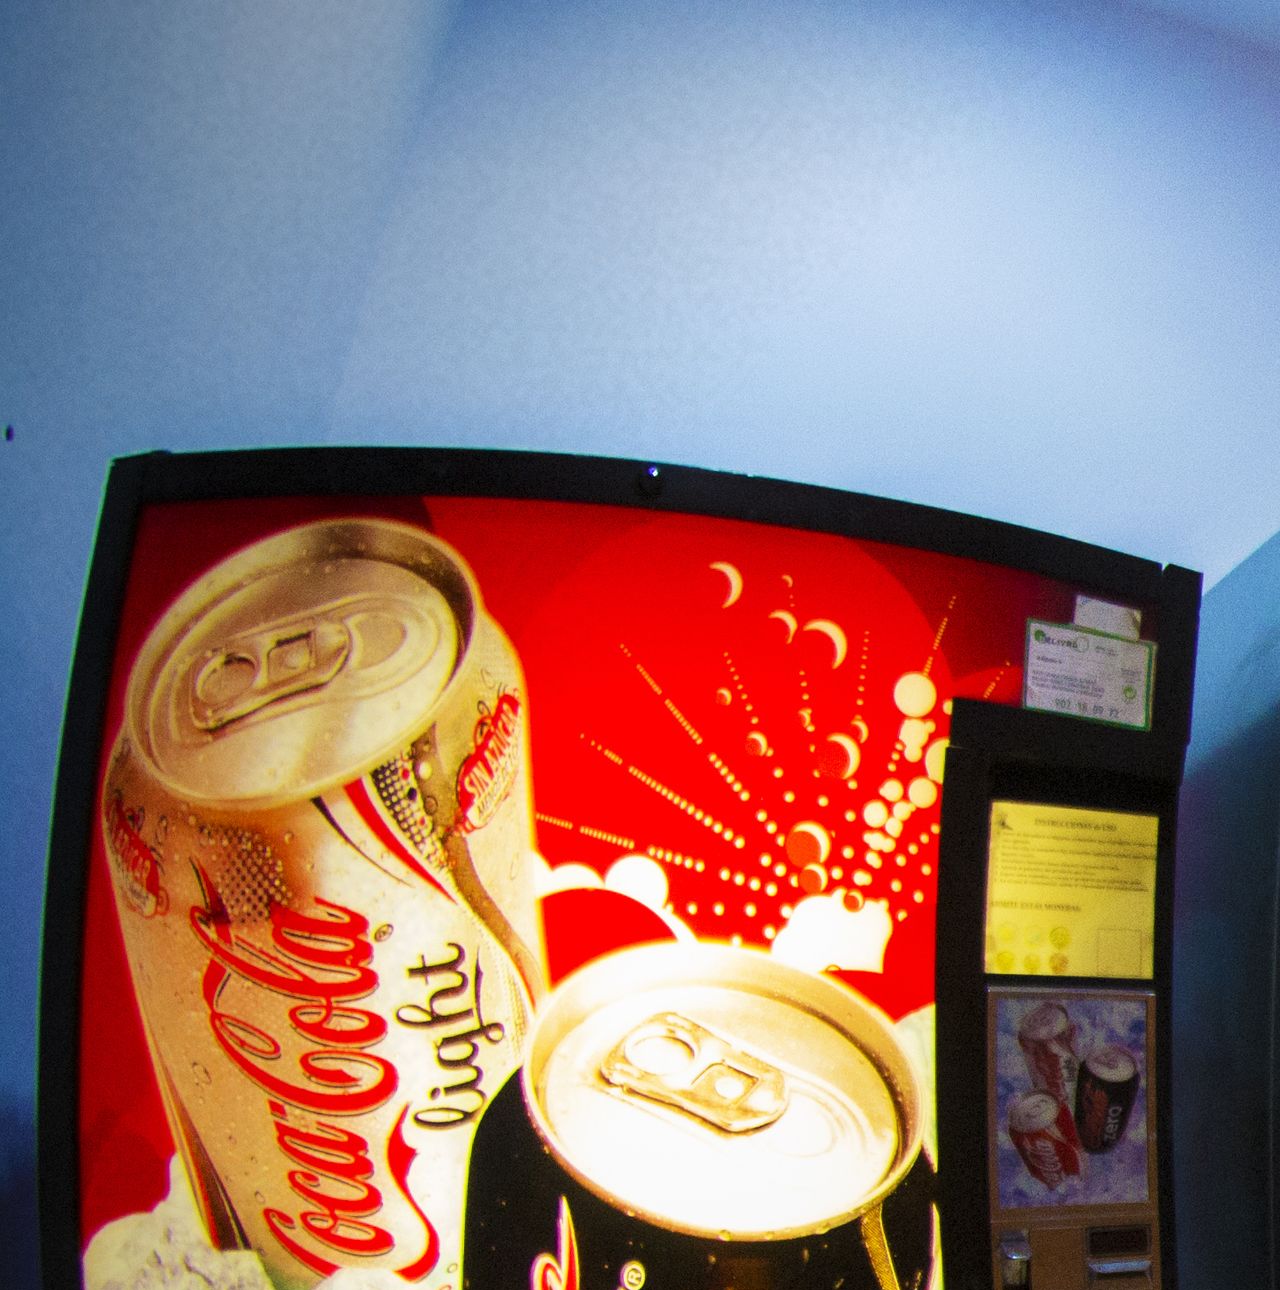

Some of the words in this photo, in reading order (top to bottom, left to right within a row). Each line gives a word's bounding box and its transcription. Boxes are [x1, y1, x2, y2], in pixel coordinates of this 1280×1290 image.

[463, 759, 495, 798] SIN
[396, 940, 506, 1133] light
[1105, 1106, 1123, 1141] zero
